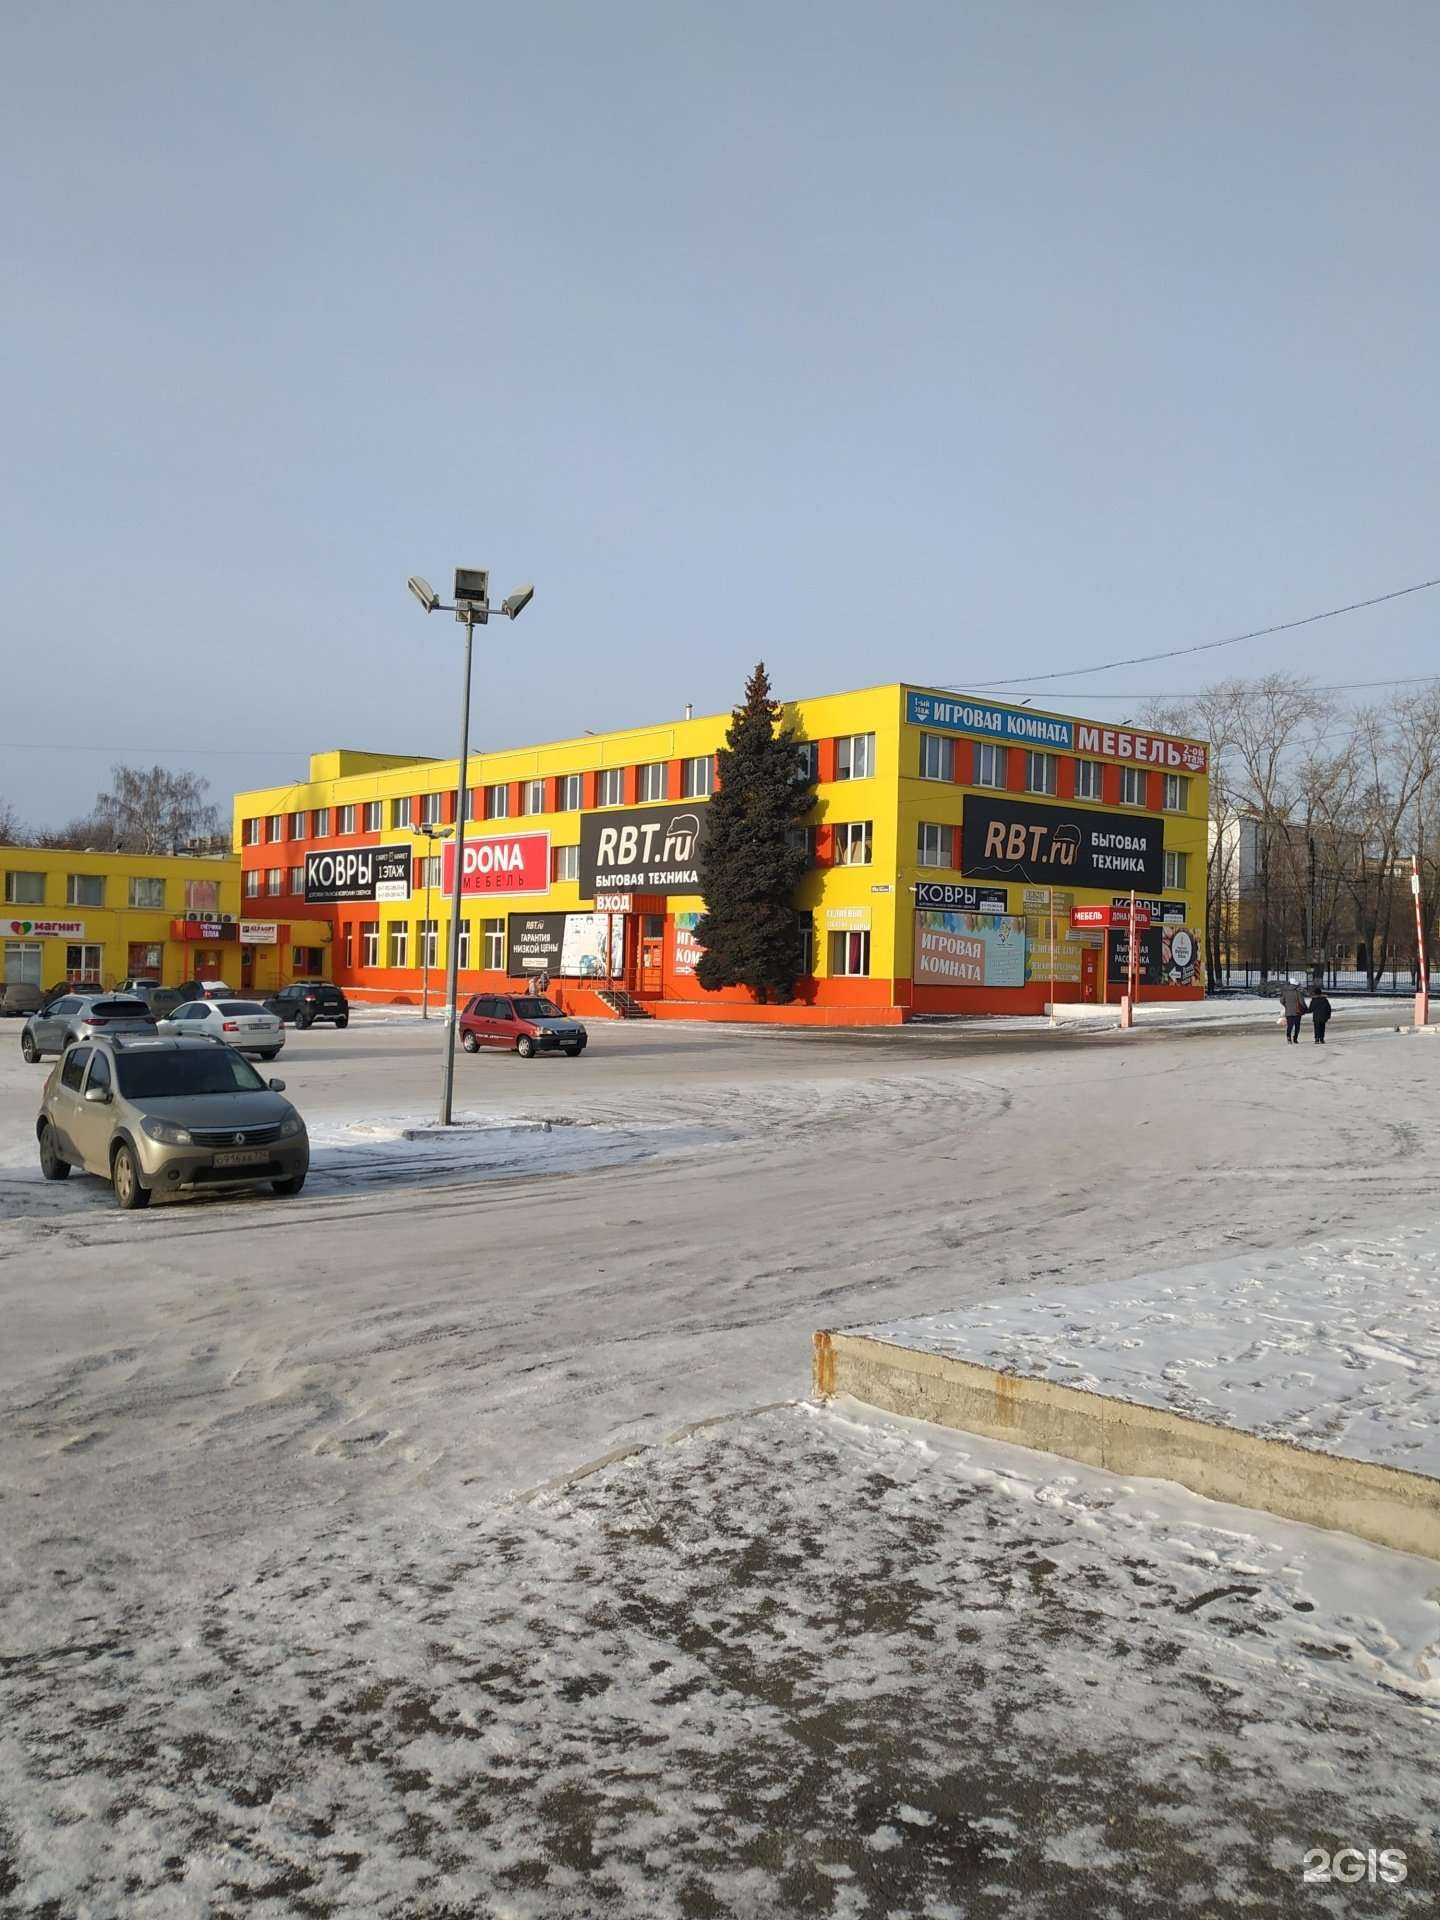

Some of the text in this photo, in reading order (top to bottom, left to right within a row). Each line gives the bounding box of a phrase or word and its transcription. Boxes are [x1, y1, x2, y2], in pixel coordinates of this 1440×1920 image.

[933, 702, 1069, 743] ИГРОВАЯ КОМНАТА
[1079, 726, 1181, 766] МЕБЕЛЬ
[597, 823, 692, 867] RBT.ru
[984, 820, 1075, 865] RBT.ru
[1091, 832, 1147, 852] БЫТОВАЯ
[463, 843, 525, 874] DONA
[1092, 854, 1145, 872] ТЕХНИКА
[308, 853, 372, 887] КОВРЫ
[595, 870, 699, 887] БЫТОВАЯ ТЕХНИКА
[463, 875, 524, 889] МЕБЕЛЬ
[596, 895, 630, 911] ВХОД
[918, 884, 976, 905] КОВРЫ
[1074, 911, 1103, 921] МЕБЕЛЬ
[513, 942, 559, 954] НИЗКОЙ ЦЕНЫ
[520, 933, 550, 942] ГАРАНТИЯ
[921, 932, 981, 958] ИГРОВАЯ
[921, 955, 981, 981] КОМНАТА
